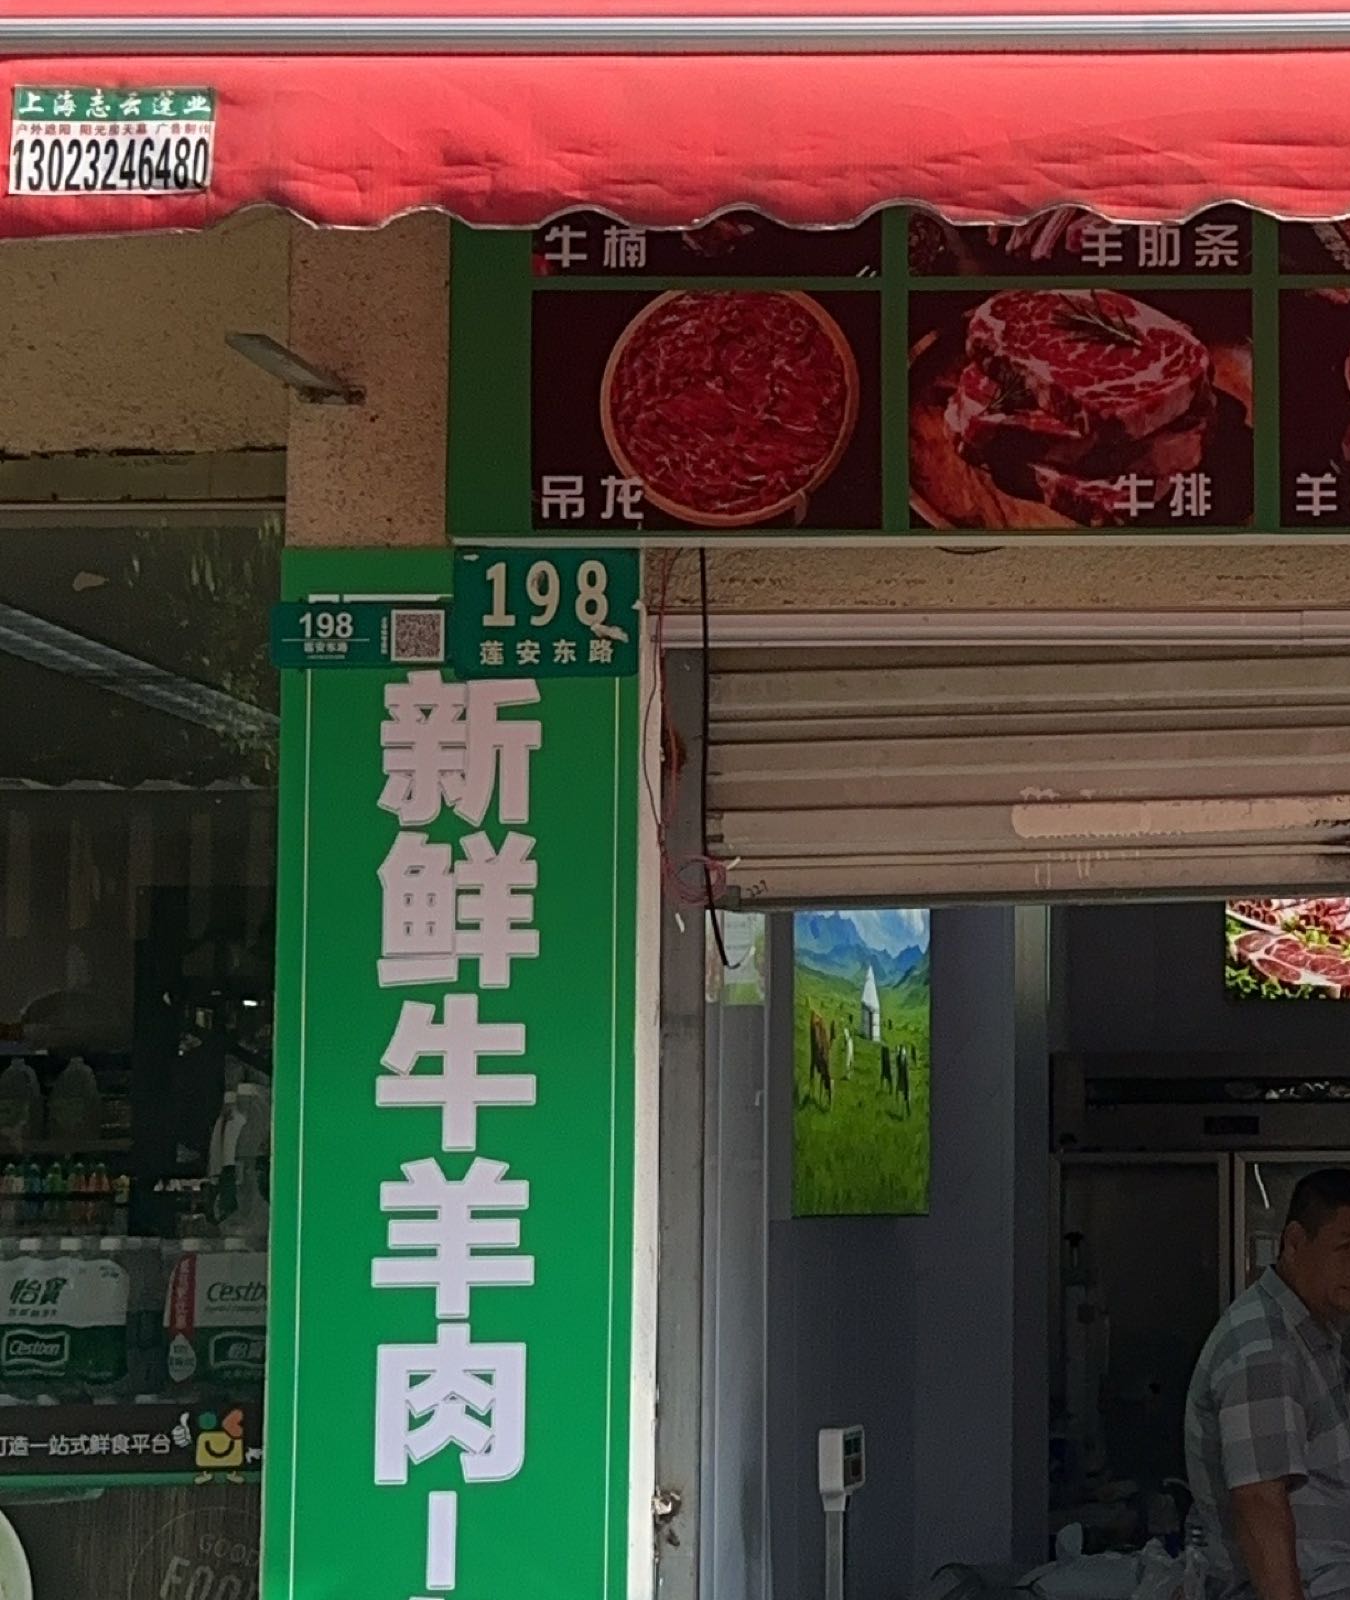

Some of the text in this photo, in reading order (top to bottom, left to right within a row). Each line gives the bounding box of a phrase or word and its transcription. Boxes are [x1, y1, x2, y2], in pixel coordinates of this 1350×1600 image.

[13, 137, 209, 191] 13023246480
[1081, 223, 1239, 267] 羊肋条
[541, 475, 644, 519] 吊龙
[1113, 473, 1211, 517] 牛排
[482, 560, 609, 627] 198
[299, 612, 354, 638] 198
[479, 639, 615, 665] 莲安东路
